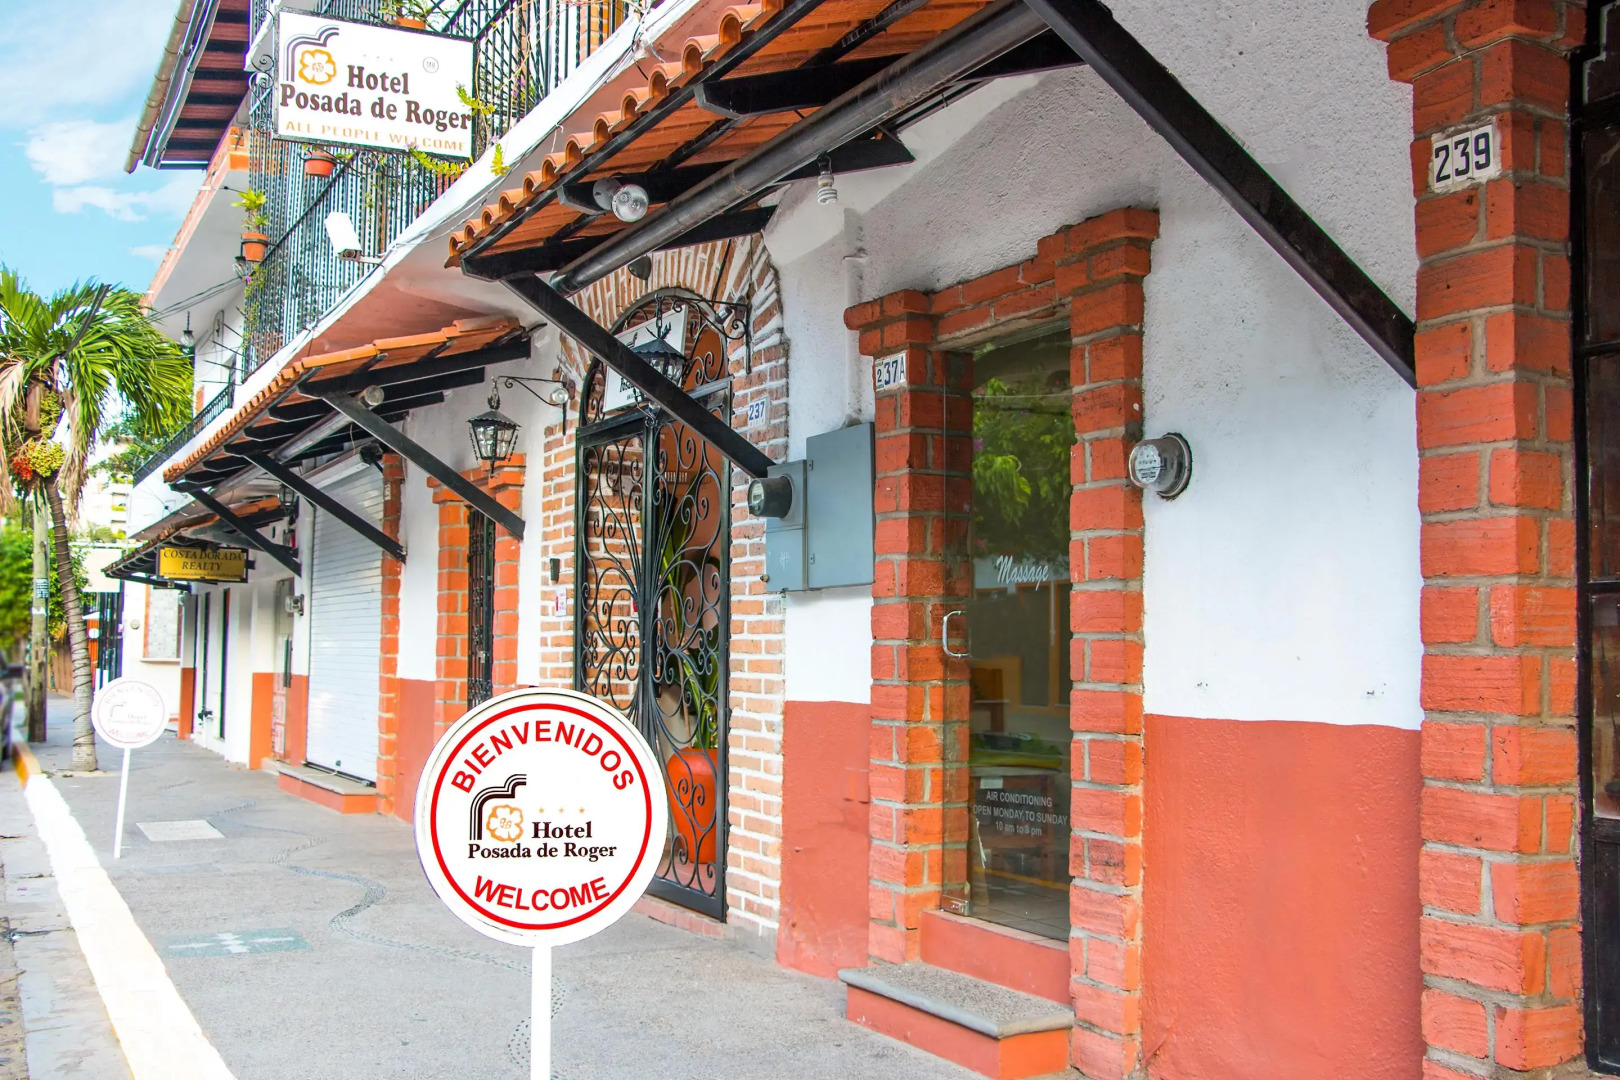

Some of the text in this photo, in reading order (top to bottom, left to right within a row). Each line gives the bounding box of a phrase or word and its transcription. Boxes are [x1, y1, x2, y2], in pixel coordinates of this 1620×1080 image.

[347, 64, 409, 95] Hotel
[280, 83, 472, 132] Posada de Roger
[285, 121, 468, 152] ALL PEOPLE WELCOME
[1434, 132, 1491, 184] 239
[877, 355, 906, 386] 237A
[749, 400, 765, 421] 237
[163, 549, 242, 561] COSTA DORADA
[182, 561, 223, 571] REALTY
[996, 555, 1049, 591] Massage
[451, 720, 634, 794] BIENVENIDOS
[986, 790, 1053, 807] AIR CONDITIONING
[972, 804, 992, 816] OPEN
[1024, 810, 1035, 821] TO
[1036, 812, 1068, 826] SUNDAY
[531, 821, 593, 839] Hotel
[995, 820, 1003, 831] 10
[1004, 823, 1015, 833] am
[1016, 824, 1024, 834] to
[1031, 826, 1042, 837] pm
[468, 842, 617, 862] Posada de Roger
[474, 875, 611, 912] WELCOME
